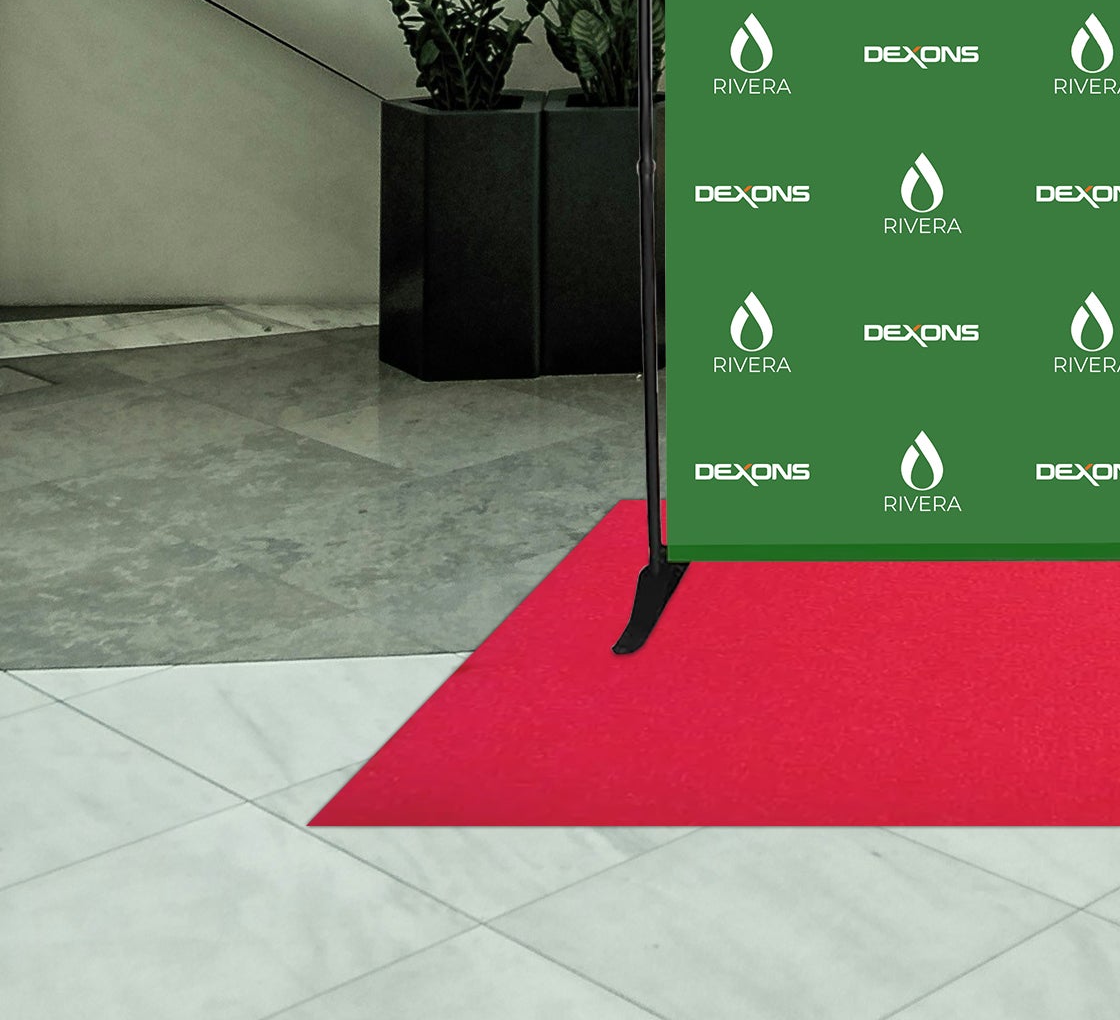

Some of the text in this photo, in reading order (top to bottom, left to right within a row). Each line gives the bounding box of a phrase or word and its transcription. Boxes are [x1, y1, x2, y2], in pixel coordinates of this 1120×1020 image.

[864, 46, 979, 69] DEXONS
[714, 79, 791, 94] RIVERA
[695, 186, 810, 208] DEXONS
[885, 218, 961, 233] RIVERA
[864, 325, 979, 347] DEXONS
[714, 357, 791, 372] RIVERA
[695, 464, 810, 486] DEXONS
[885, 496, 961, 511] RIVERA
